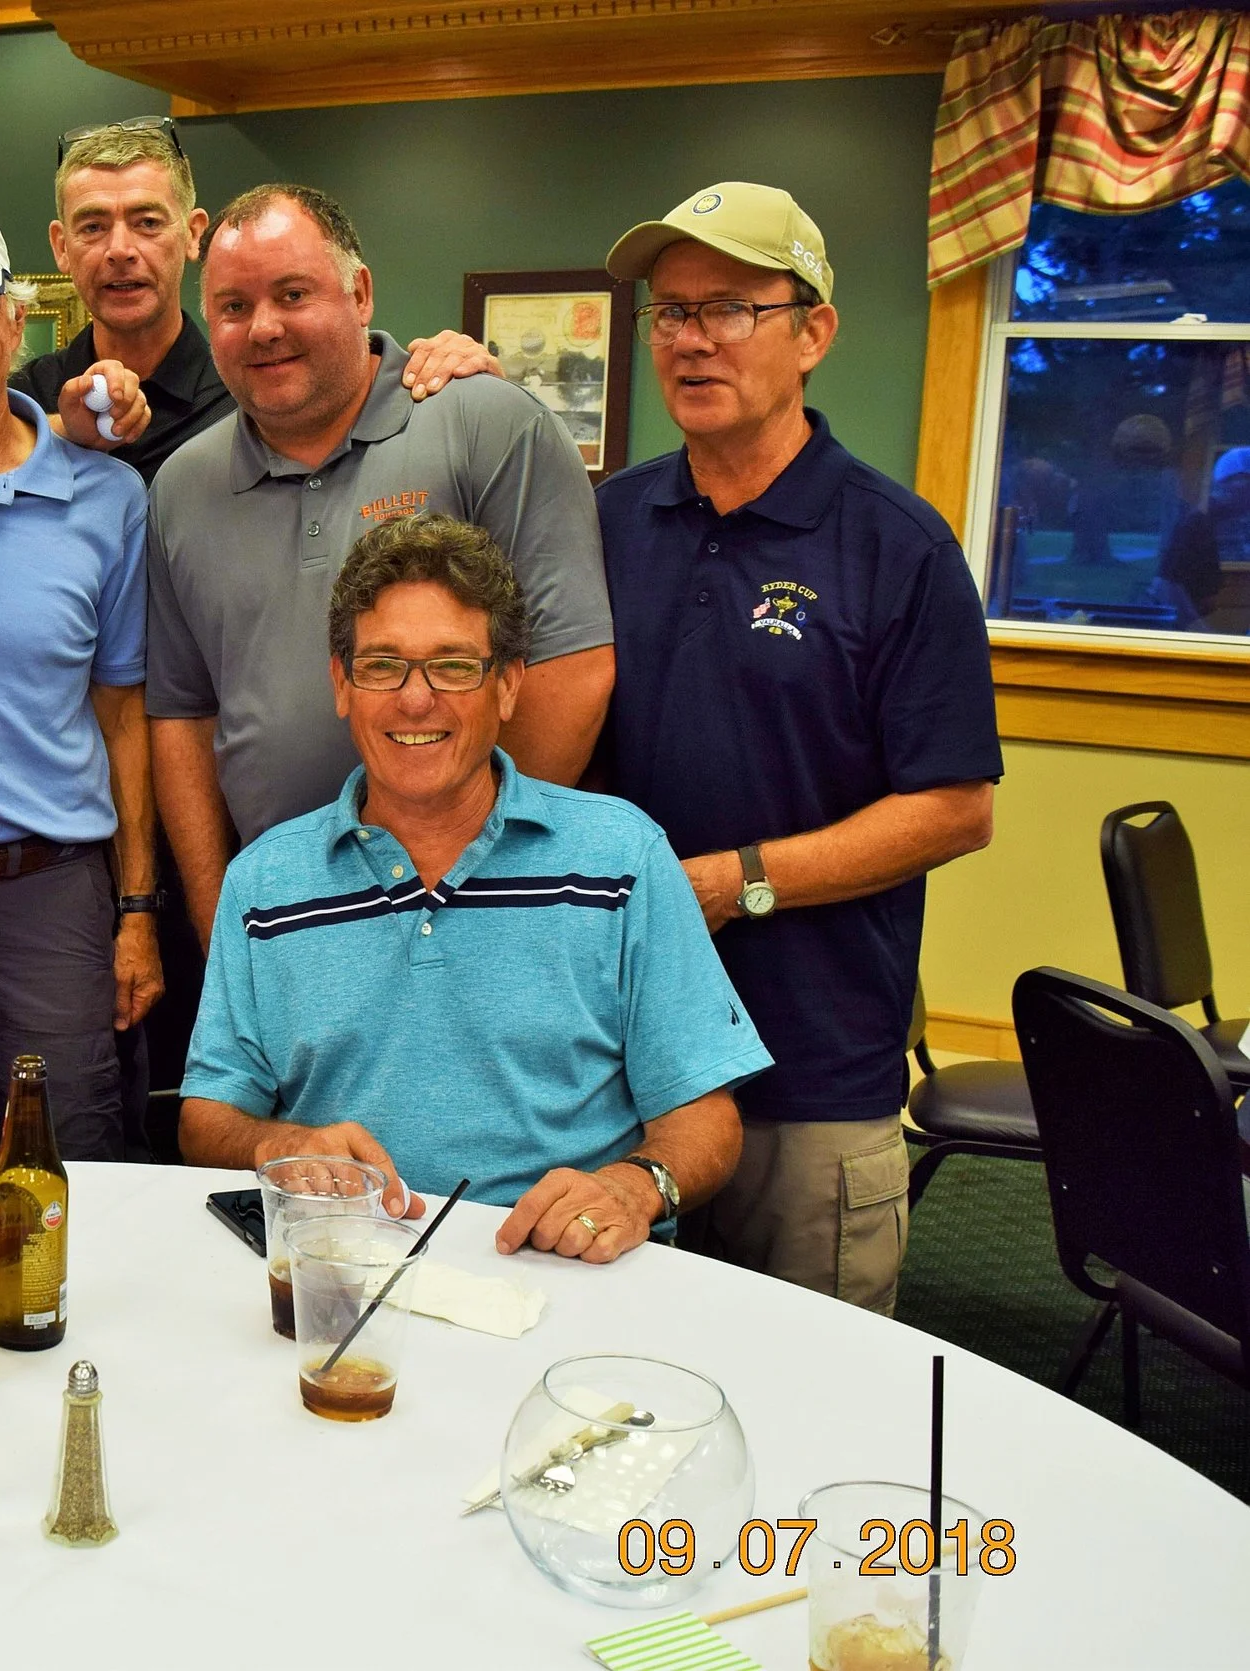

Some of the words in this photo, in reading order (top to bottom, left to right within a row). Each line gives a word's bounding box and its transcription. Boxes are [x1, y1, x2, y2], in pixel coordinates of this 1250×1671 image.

[361, 490, 429, 519] BULLEIT
[761, 581, 798, 593] RYDER
[797, 585, 818, 600] CUP
